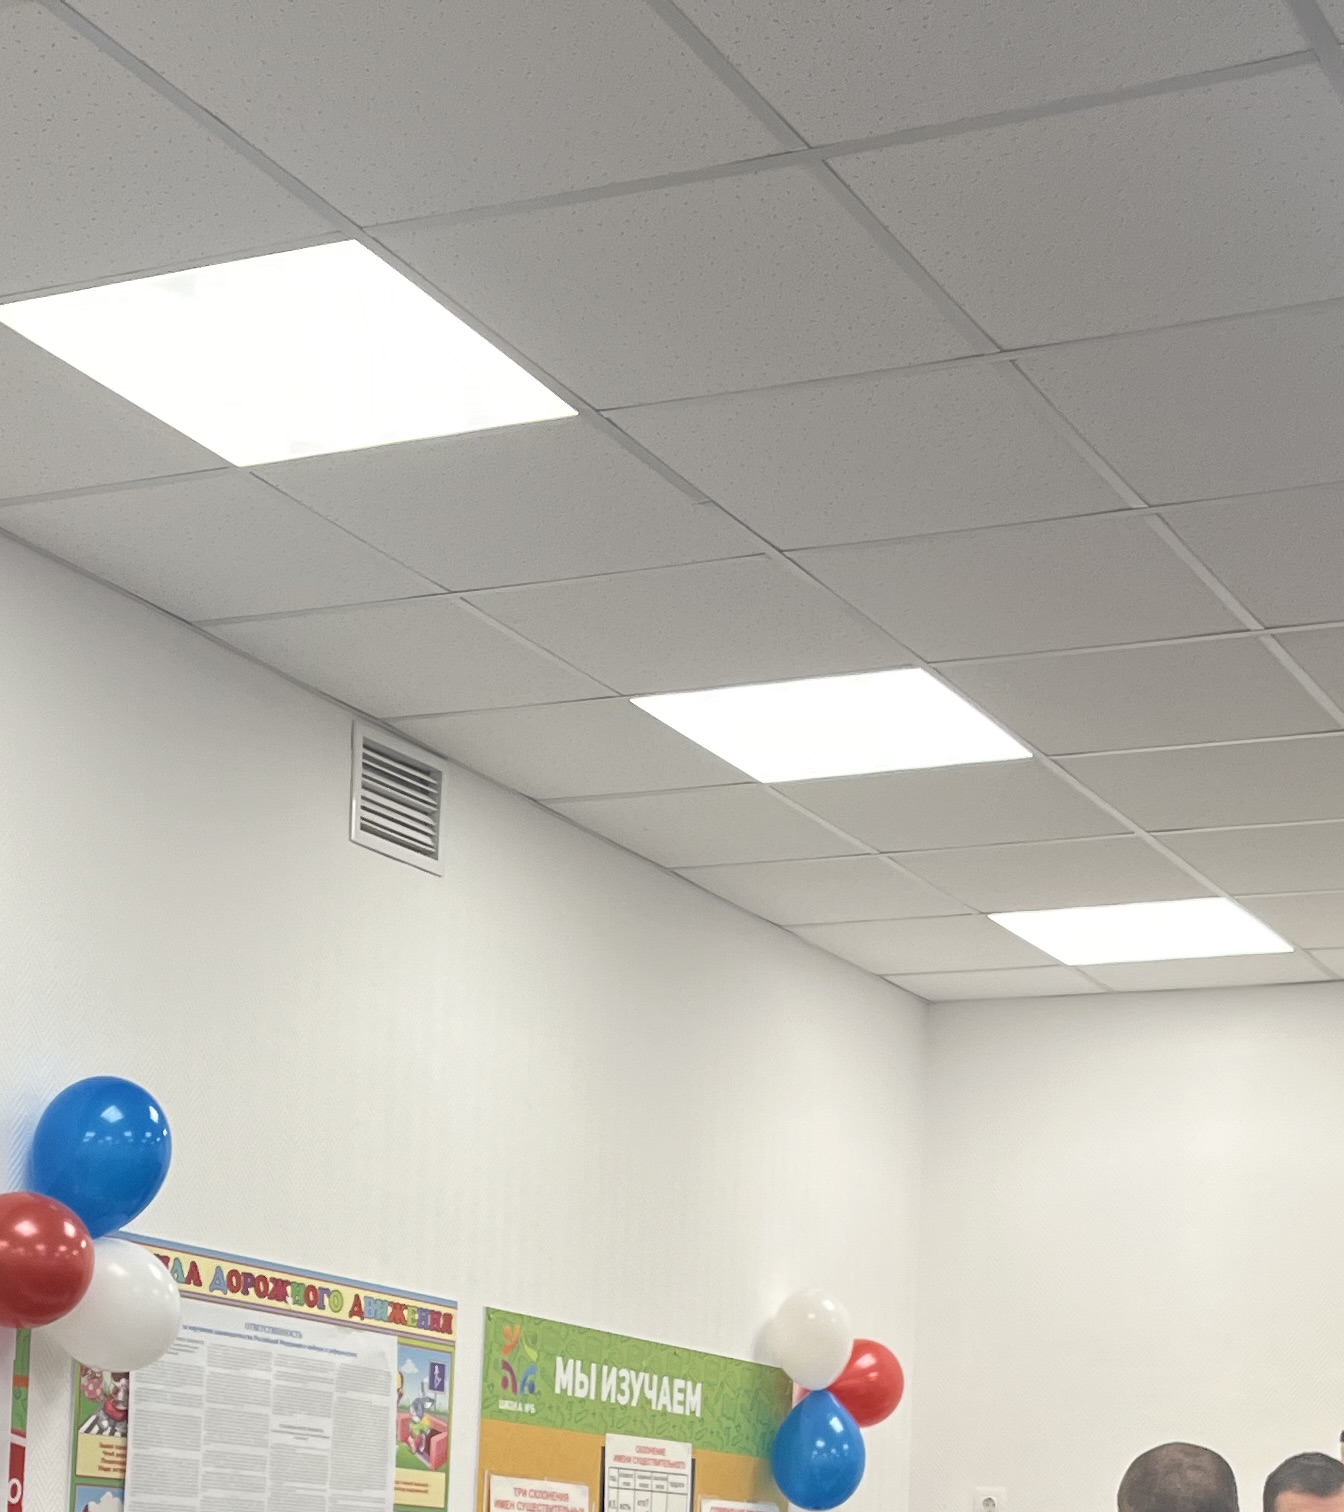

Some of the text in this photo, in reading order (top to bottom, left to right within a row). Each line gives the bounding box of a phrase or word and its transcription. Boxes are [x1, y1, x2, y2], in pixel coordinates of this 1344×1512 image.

[208, 1265, 344, 1314] ДОРОЖНОГО
[348, 1293, 454, 1335] ДВИЖЕНИЯ
[554, 1356, 703, 1418] МЫ ИЗУЧАЕМ
